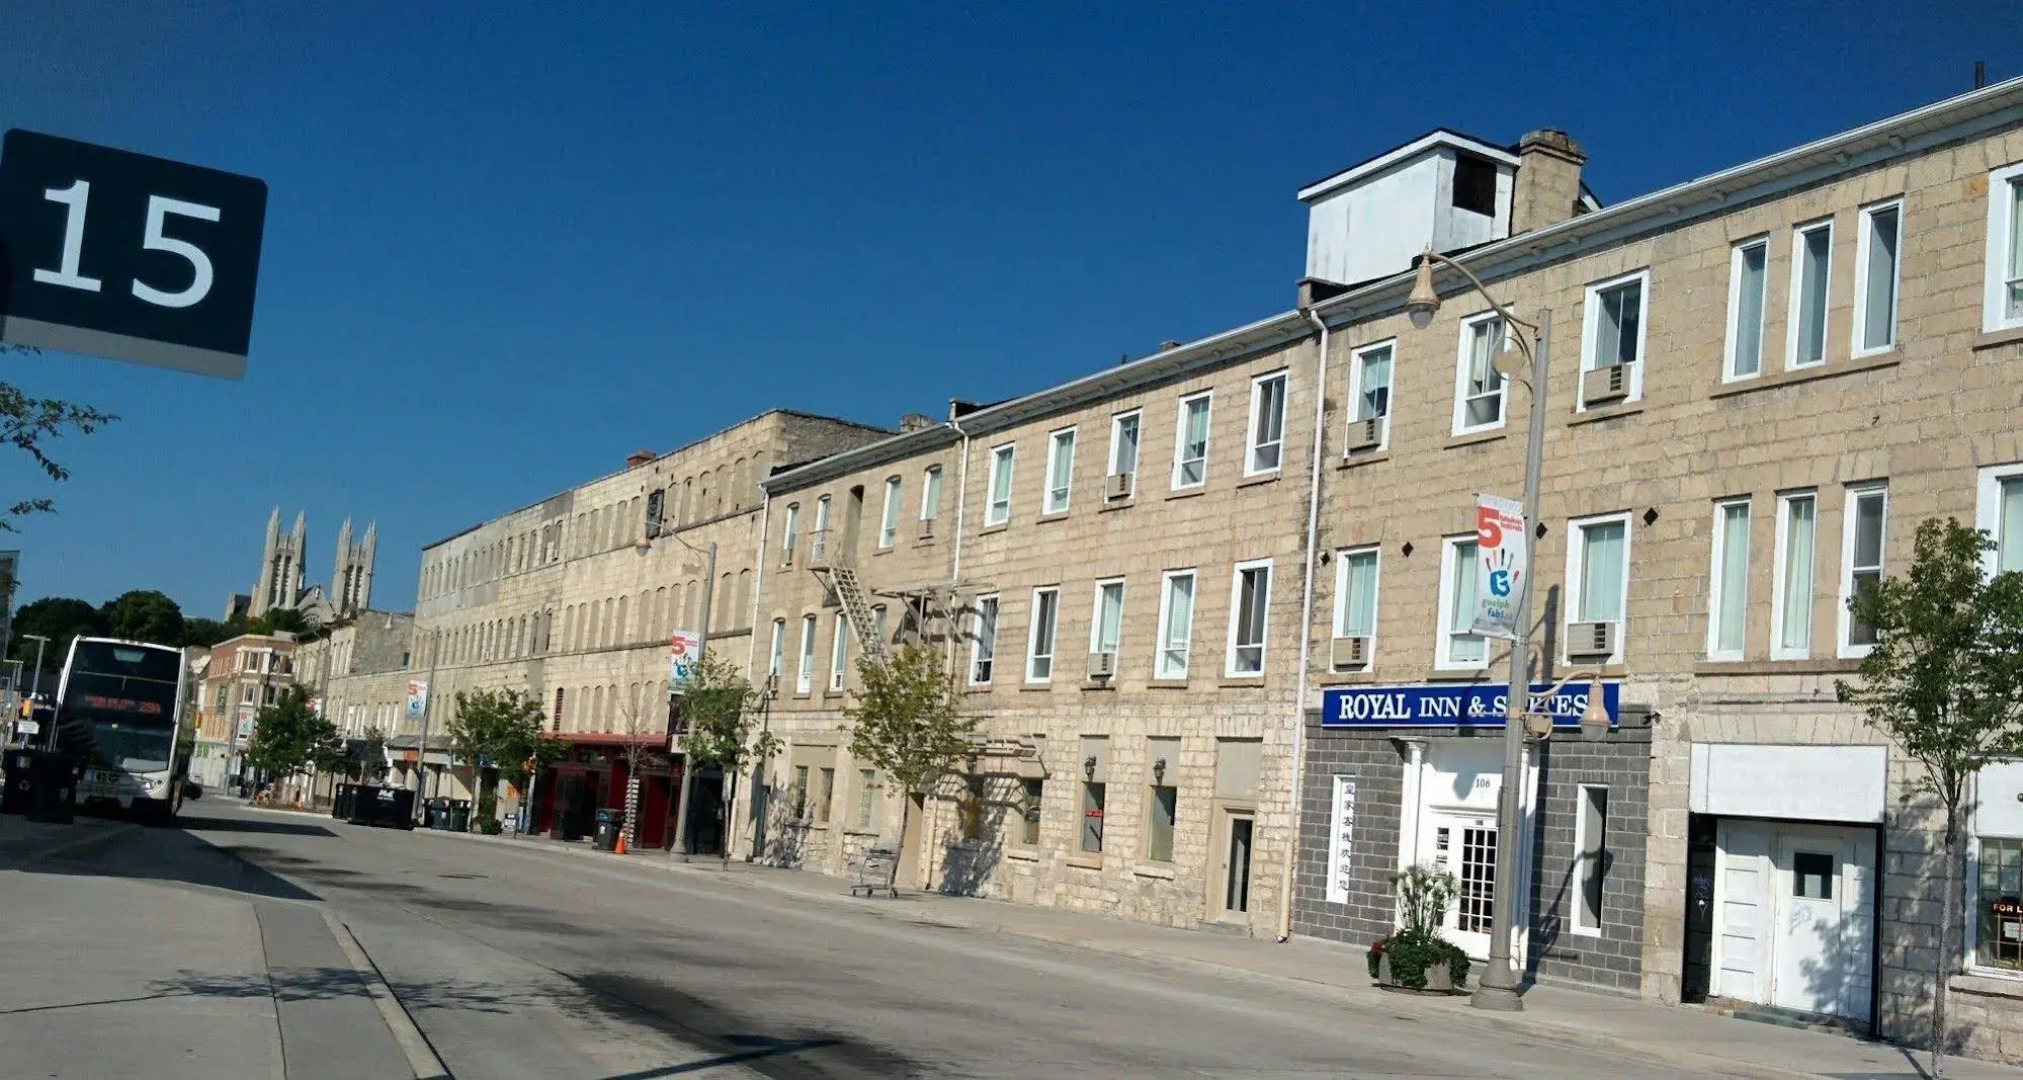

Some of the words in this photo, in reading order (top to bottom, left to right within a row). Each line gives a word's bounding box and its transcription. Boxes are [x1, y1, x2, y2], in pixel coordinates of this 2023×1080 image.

[33, 178, 221, 308] 15
[1478, 506, 1502, 548] 5
[672, 636, 685, 655] 5
[1339, 693, 1411, 719] ROYAL
[1419, 696, 1461, 717] INN
[1467, 696, 1486, 718] &
[1493, 694, 1589, 718] SITES
[1475, 778, 1491, 788] 106
[1993, 902, 2014, 913] FOR
